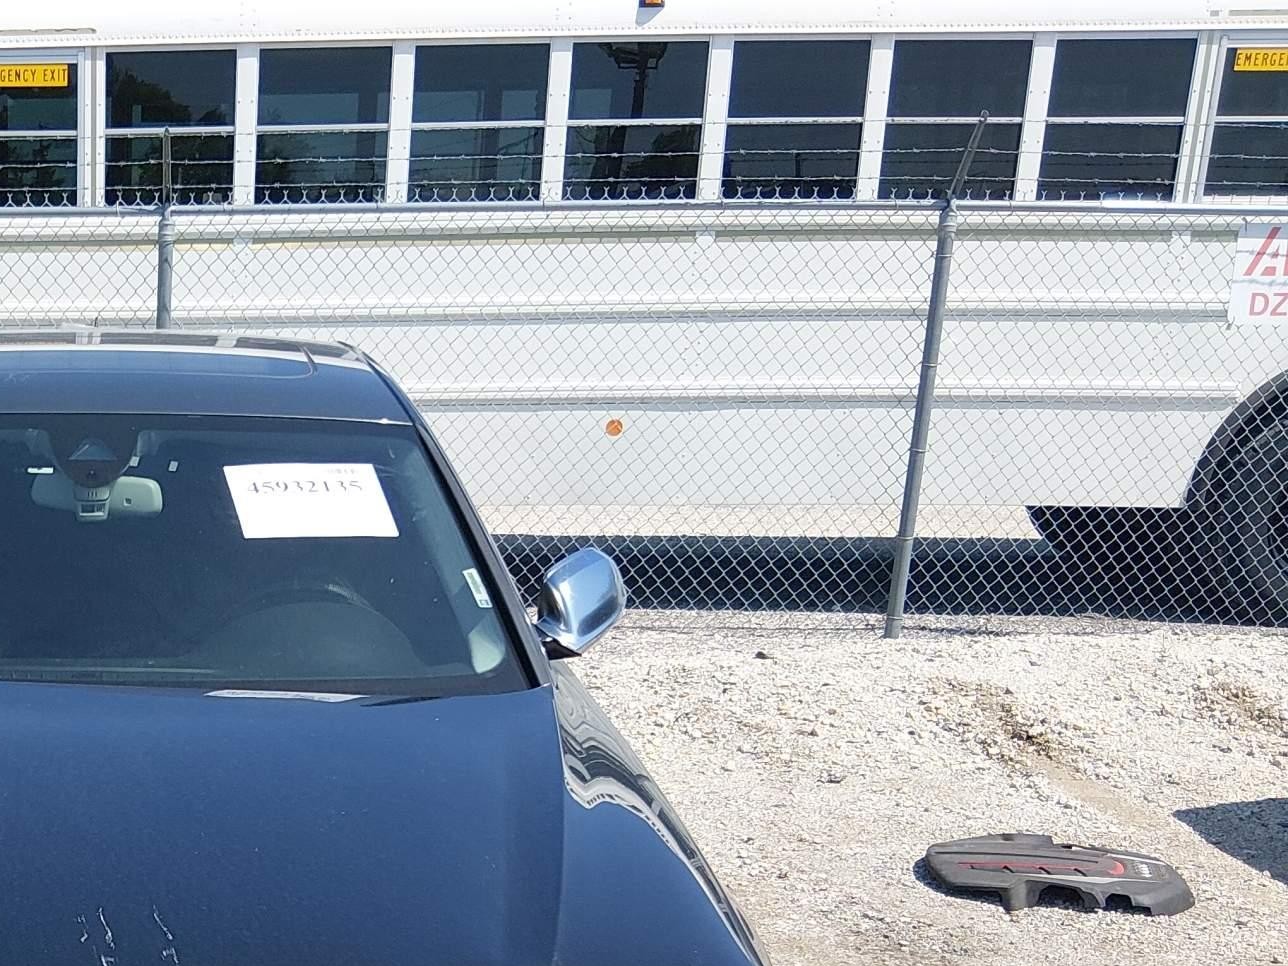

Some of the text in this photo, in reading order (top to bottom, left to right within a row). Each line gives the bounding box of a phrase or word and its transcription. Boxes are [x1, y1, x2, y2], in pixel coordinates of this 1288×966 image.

[43, 69, 67, 82] EXIT
[1243, 226, 1288, 276] A
[248, 480, 364, 494] 45932135
